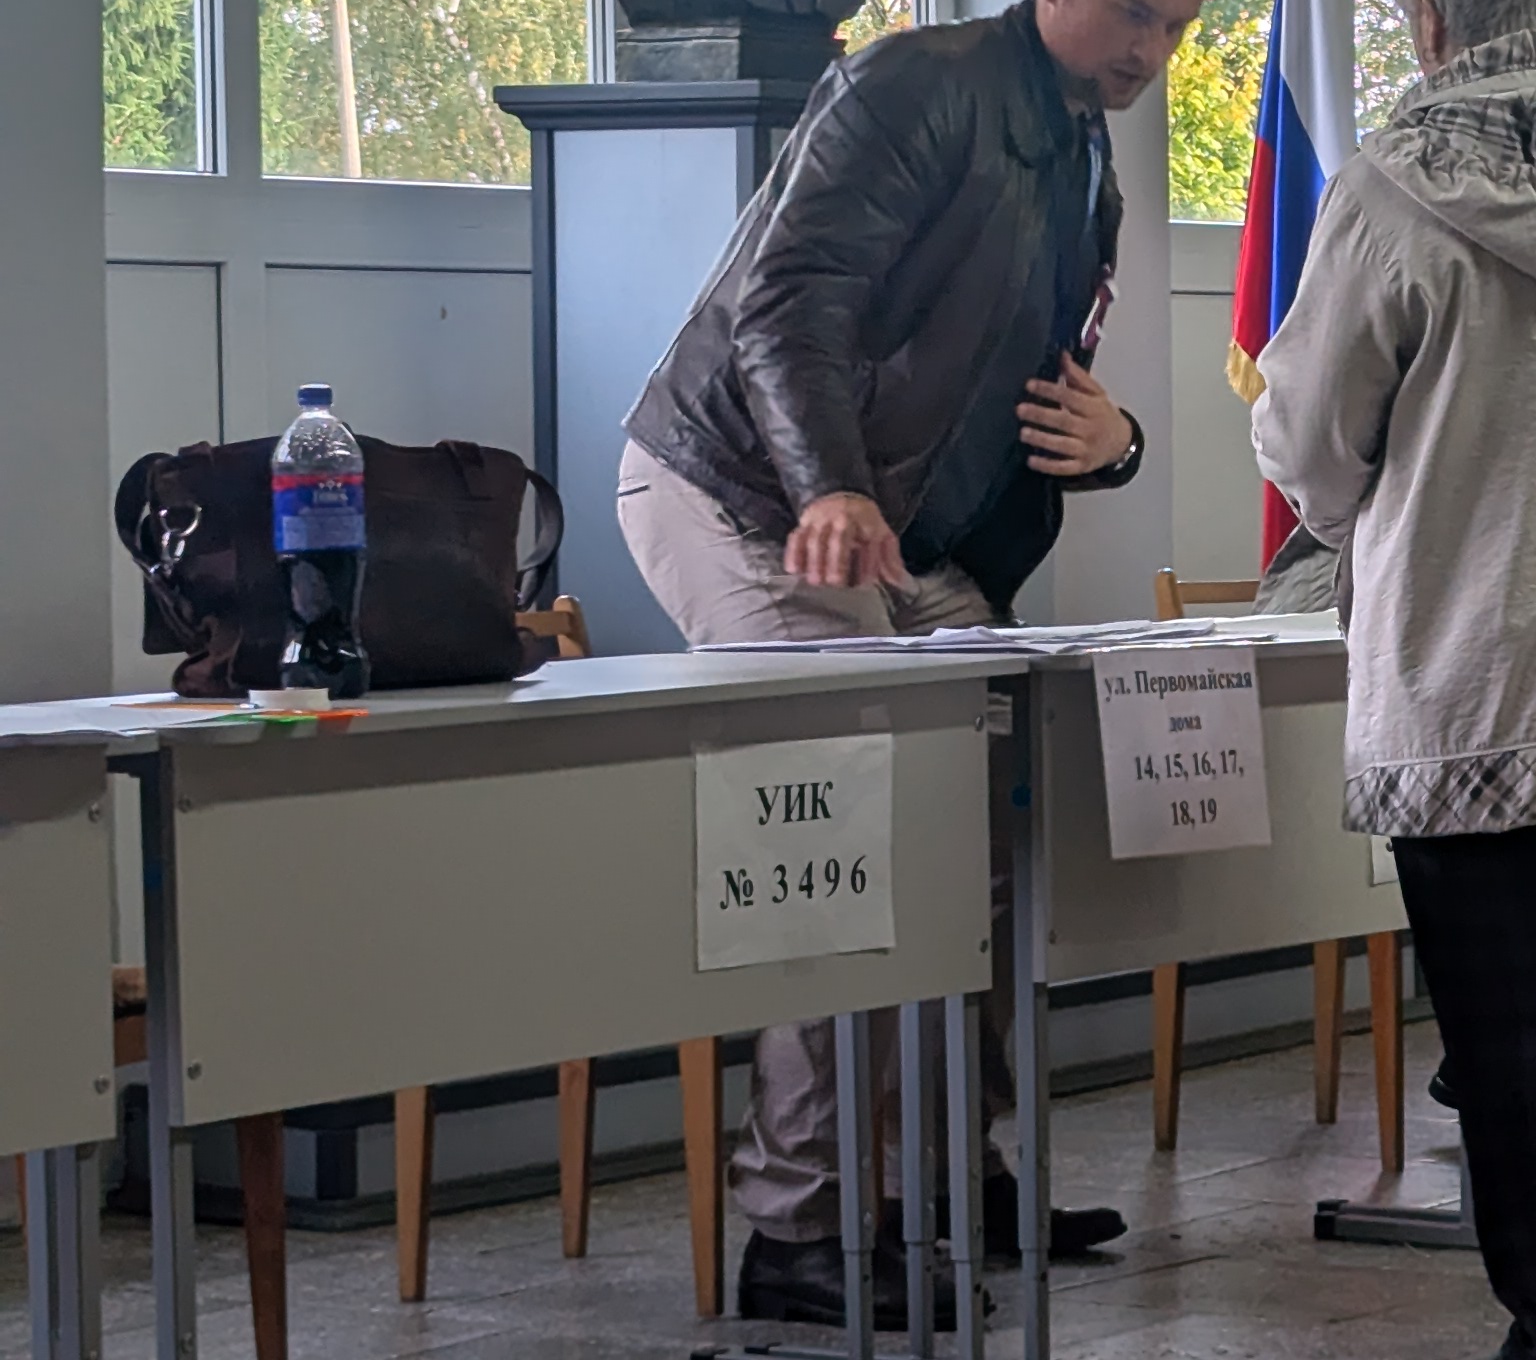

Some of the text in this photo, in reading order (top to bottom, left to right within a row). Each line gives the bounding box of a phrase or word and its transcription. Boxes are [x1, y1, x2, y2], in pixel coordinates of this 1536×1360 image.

[1104, 668, 1253, 703] ул. Первомайская
[1169, 715, 1202, 733] дома
[1135, 749, 1244, 786] 14, 15, 16, 17,
[755, 780, 834, 826] УИК
[1171, 798, 1218, 831] 18, 19
[719, 854, 867, 911] № 3496
